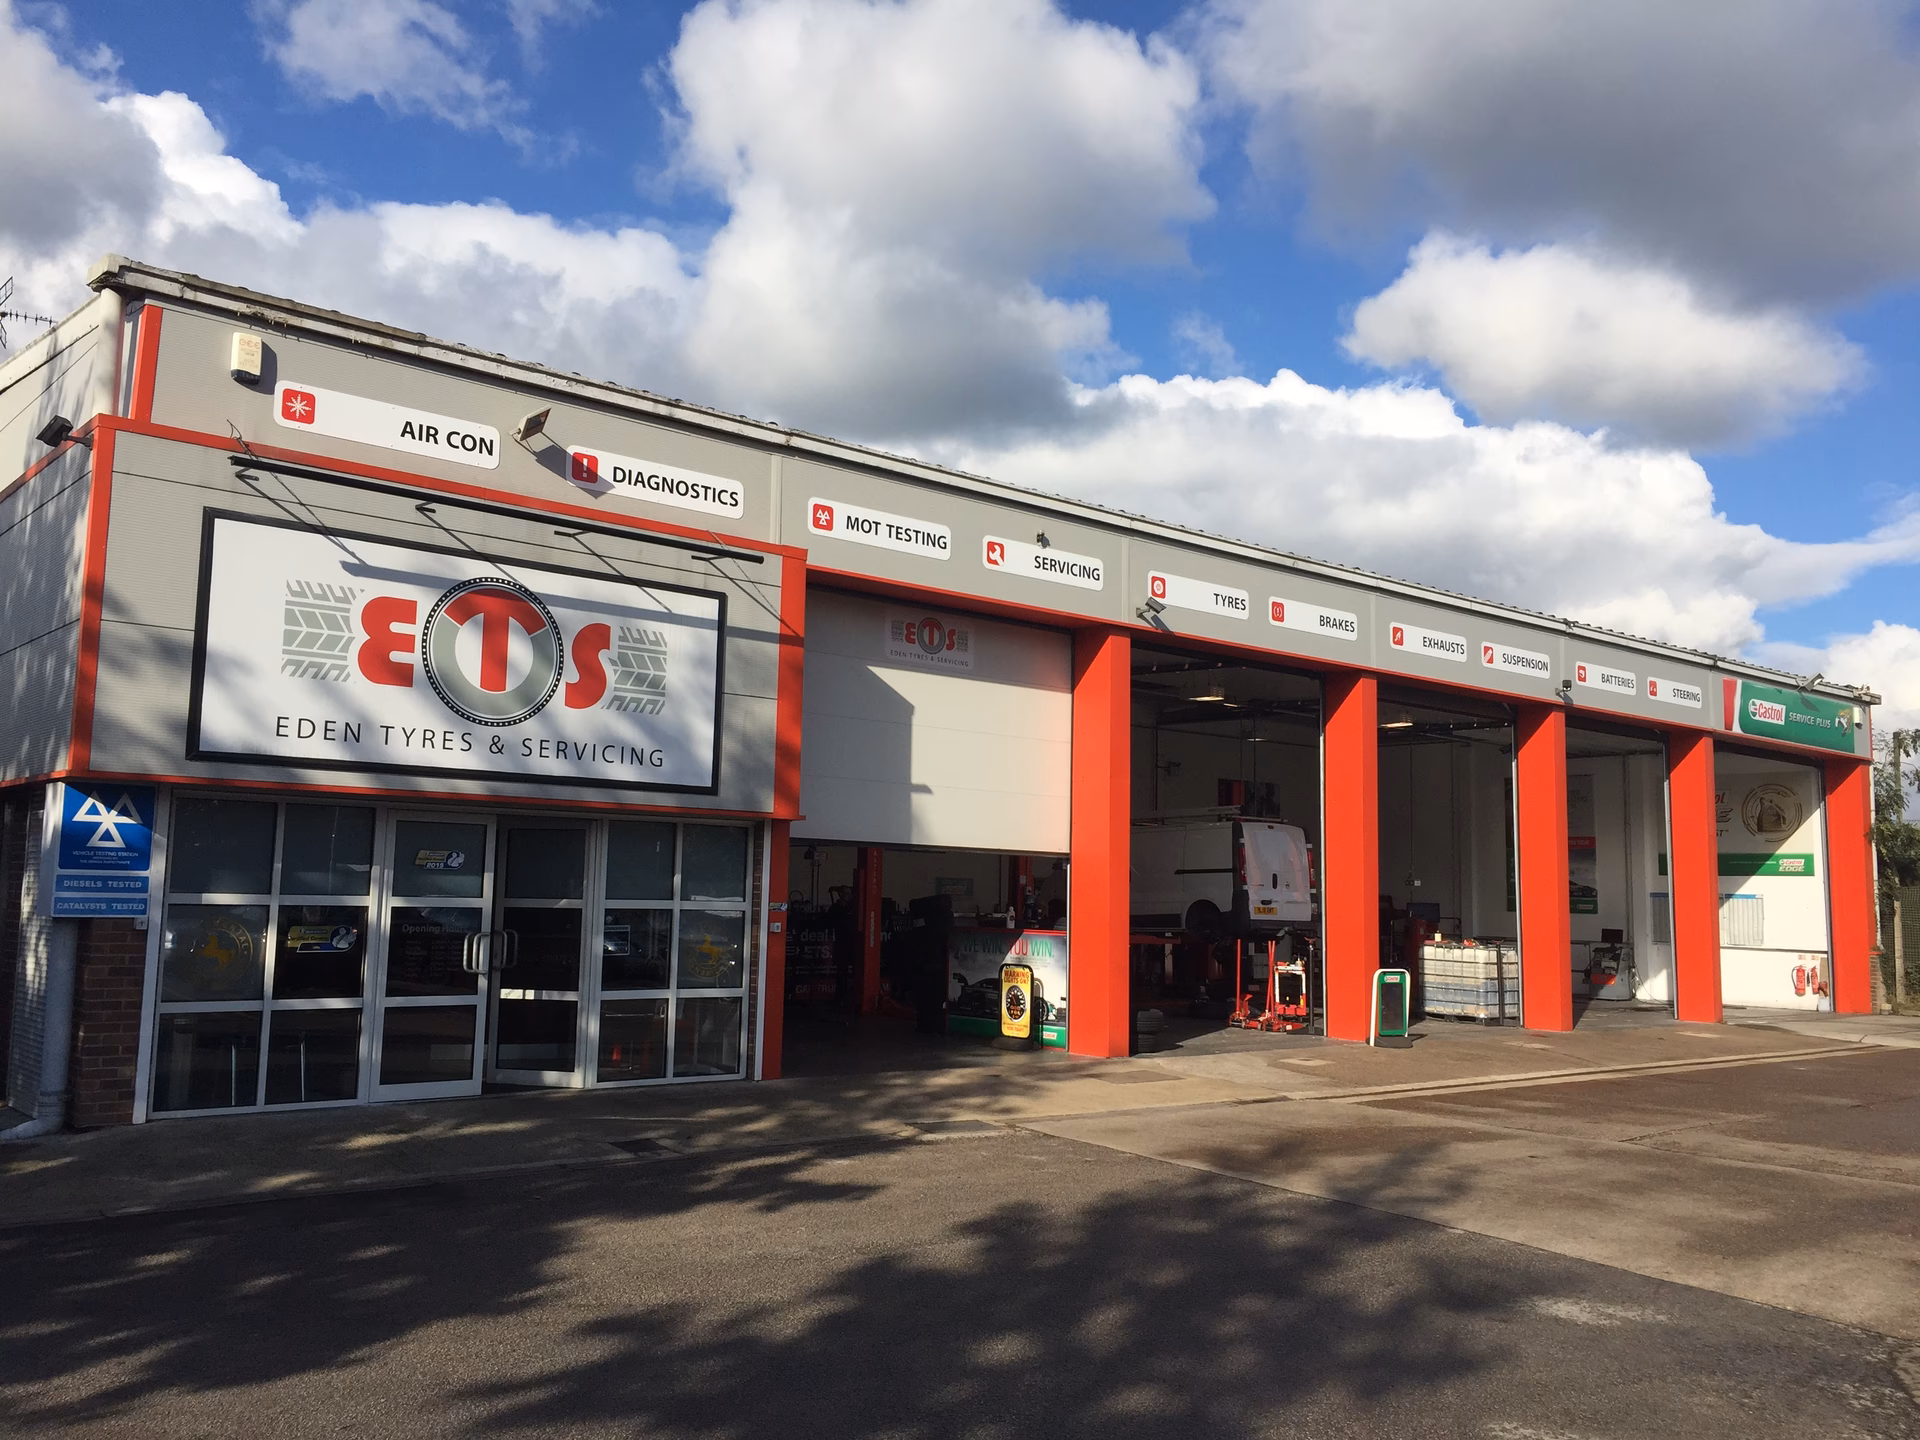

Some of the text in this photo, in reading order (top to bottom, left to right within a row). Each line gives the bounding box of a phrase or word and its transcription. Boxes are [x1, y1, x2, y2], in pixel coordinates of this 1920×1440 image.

[400, 420, 494, 457] AIR CON
[612, 465, 740, 507] DIAGNOSTICS
[846, 515, 947, 550] MOT TESTING
[1034, 555, 1100, 581] SERVICING
[1213, 593, 1246, 612] TYRES
[1319, 614, 1355, 633] BRAKES
[904, 619, 956, 651] ETS
[357, 586, 612, 710] ETS
[1422, 636, 1465, 655] EXHAUSTS
[890, 649, 907, 658] EDEN
[909, 652, 928, 661] TYRES
[937, 656, 969, 667] SERVICING
[1502, 652, 1549, 672] SUSPENSION
[1601, 673, 1635, 689] BATTERIES
[1672, 688, 1701, 703] STEERING
[1757, 703, 1831, 729] Castrol SERVICE PLUS
[275, 716, 665, 768] EDEN TYRES & SERVICING
[63, 880, 102, 888] DIESELS
[56, 902, 107, 910] CATALYSTS
[402, 924, 441, 934] Opening
[964, 937, 1054, 958] WE WIN. YOU WIN.
[1004, 969, 1029, 979] WARNING
